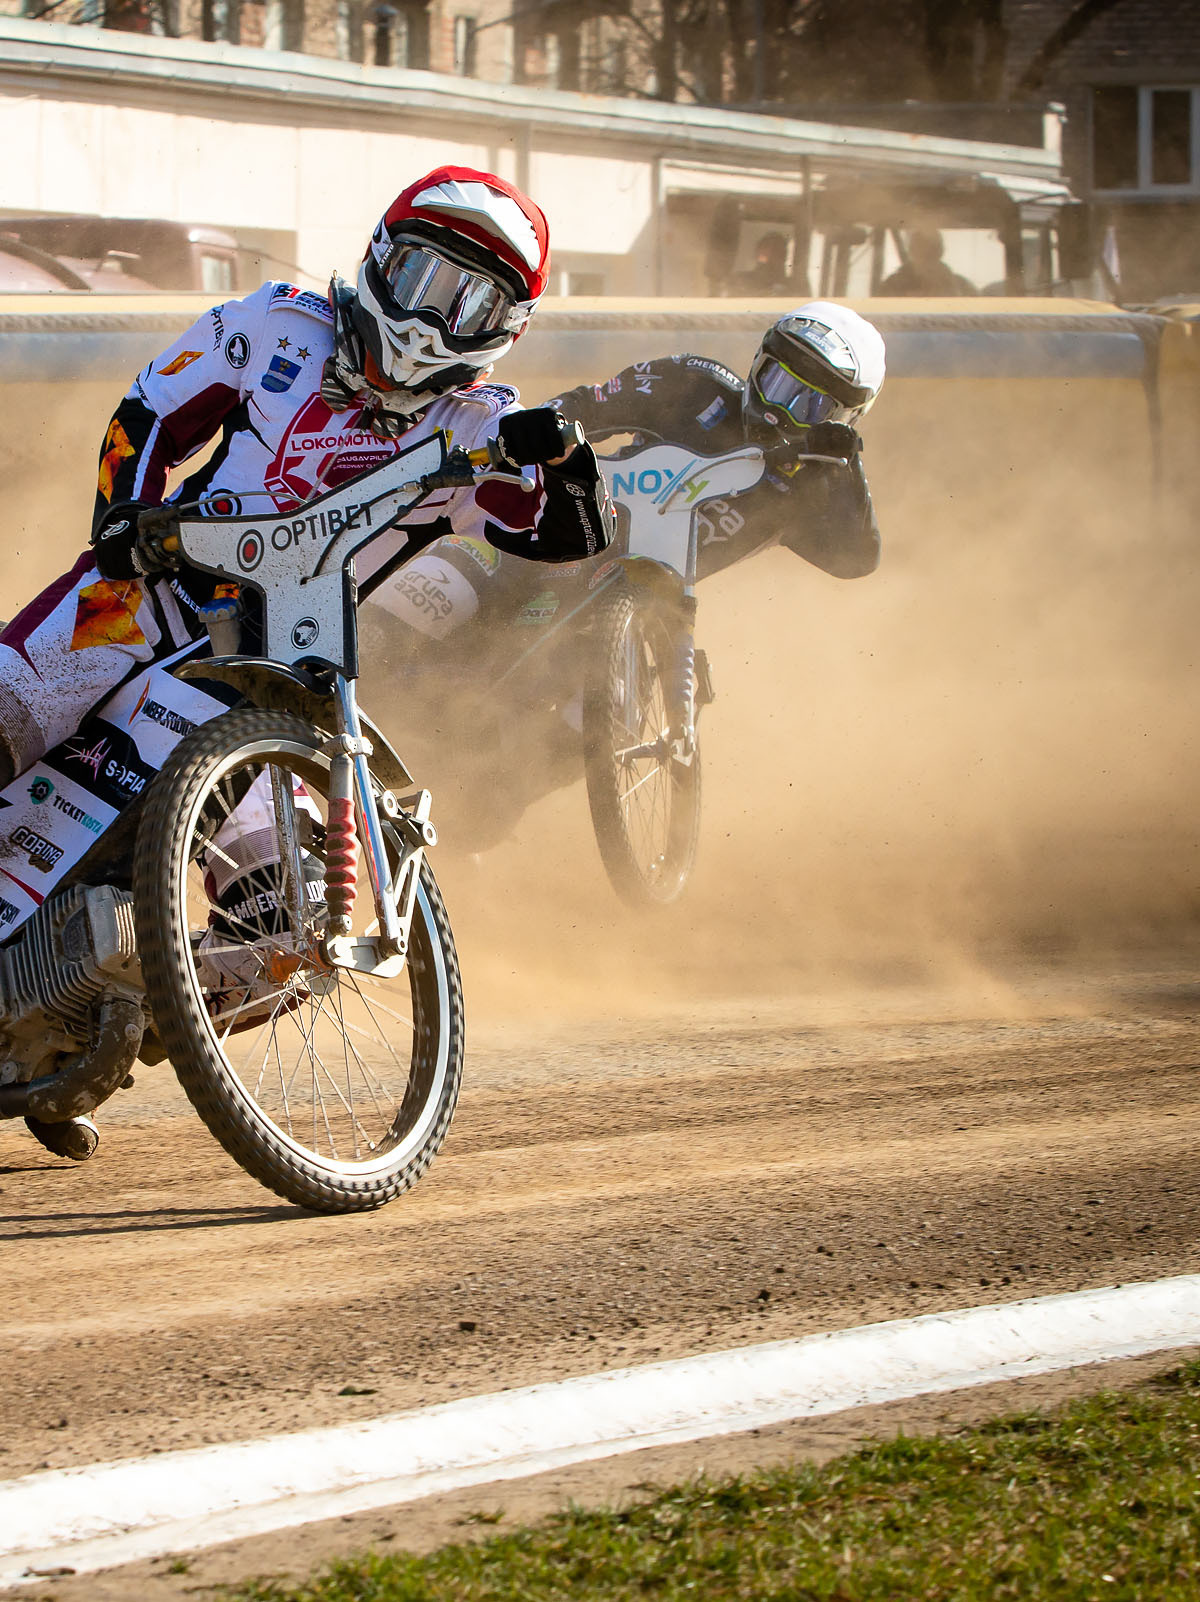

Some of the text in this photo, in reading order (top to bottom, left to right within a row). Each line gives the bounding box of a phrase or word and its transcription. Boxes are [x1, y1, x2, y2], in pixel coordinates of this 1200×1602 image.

[686, 358, 741, 386] CHEMART
[337, 454, 388, 463] AUGAVPILS
[271, 502, 372, 551] OPTIBET
